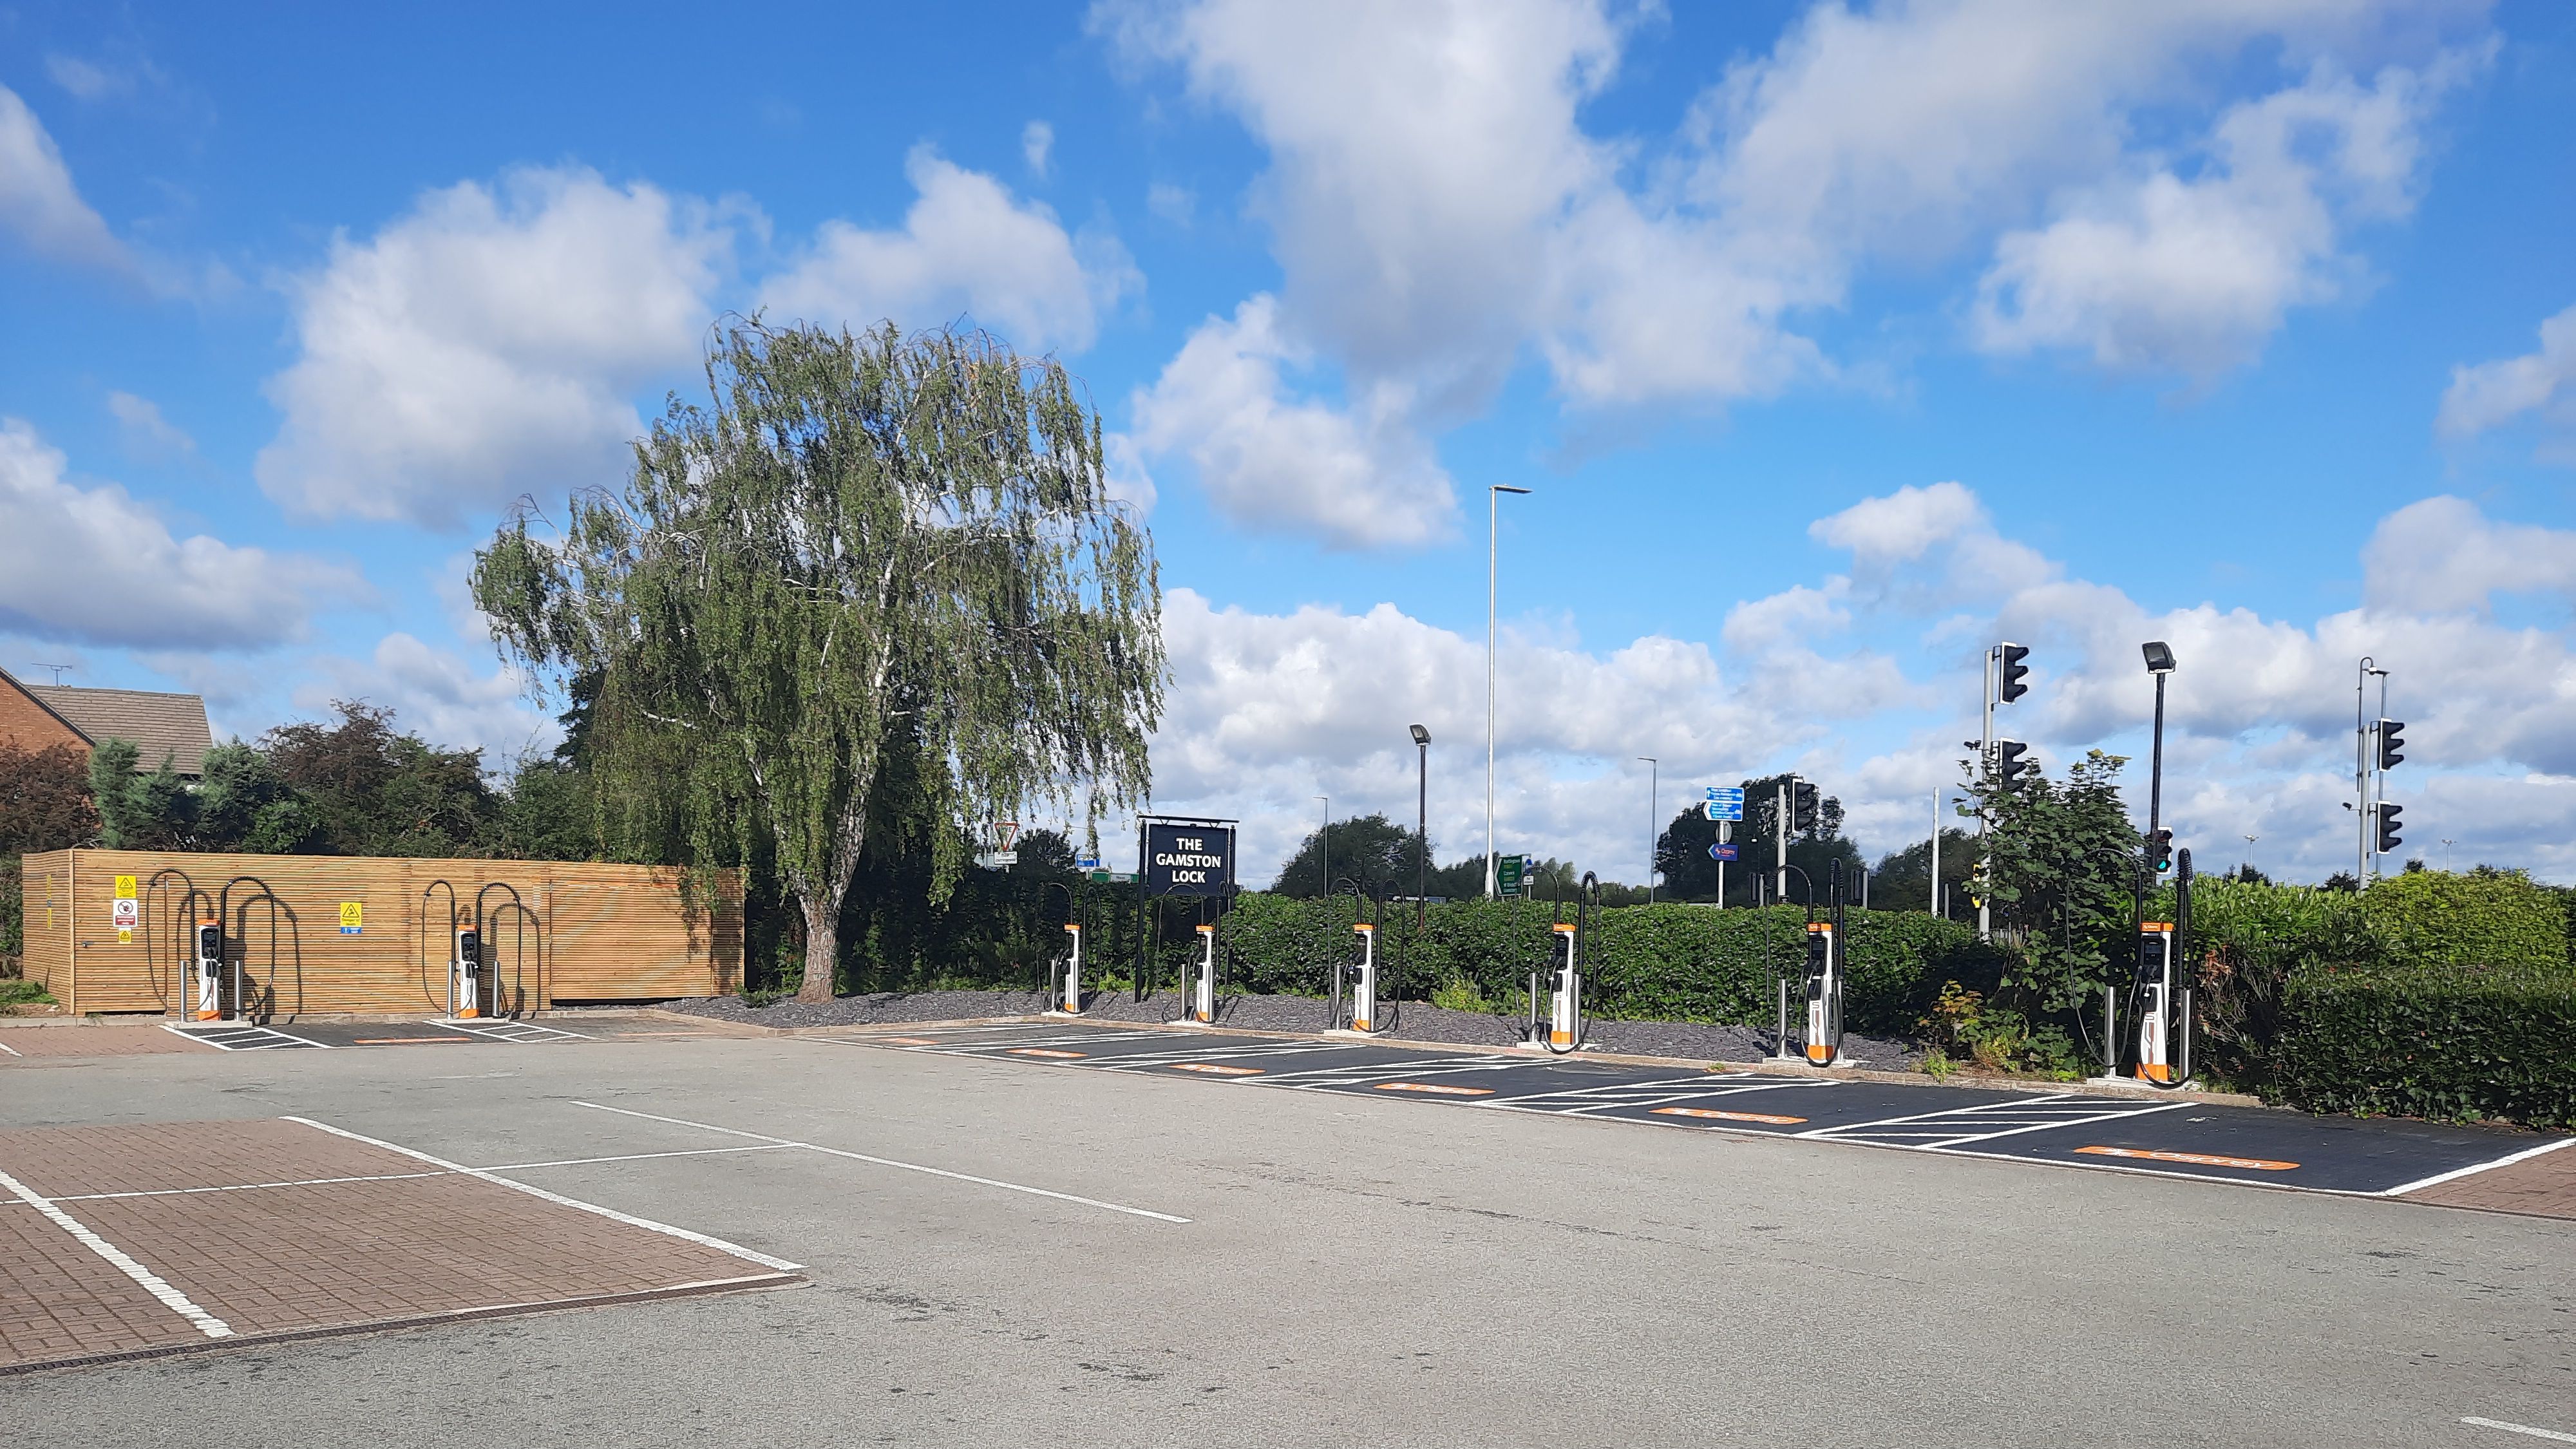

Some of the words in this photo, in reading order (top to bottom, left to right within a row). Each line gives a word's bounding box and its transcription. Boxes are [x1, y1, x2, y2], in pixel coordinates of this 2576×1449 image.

[1176, 838, 1202, 851] THE
[1156, 853, 1221, 867] GAMSTON
[1172, 870, 1206, 883] LOCK
